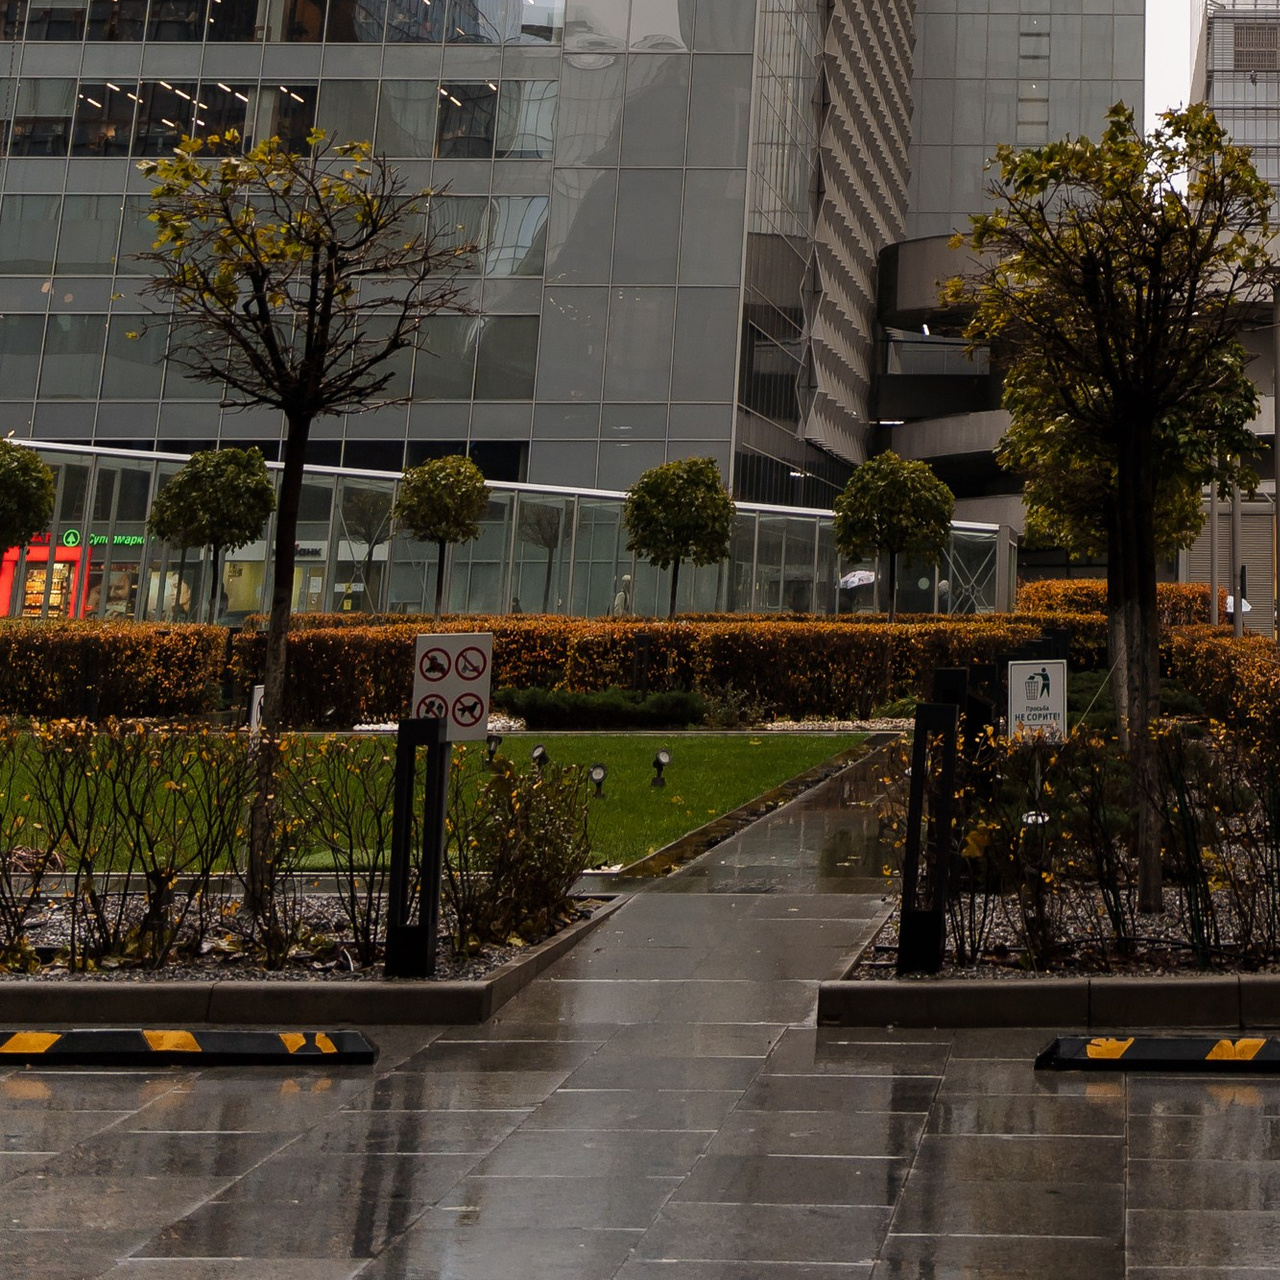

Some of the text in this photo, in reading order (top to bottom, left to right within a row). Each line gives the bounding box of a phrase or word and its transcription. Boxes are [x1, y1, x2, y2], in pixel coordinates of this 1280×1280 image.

[89, 533, 155, 546] Супмарк
[1014, 712, 1061, 721] НЕ СОРИТЕ!
